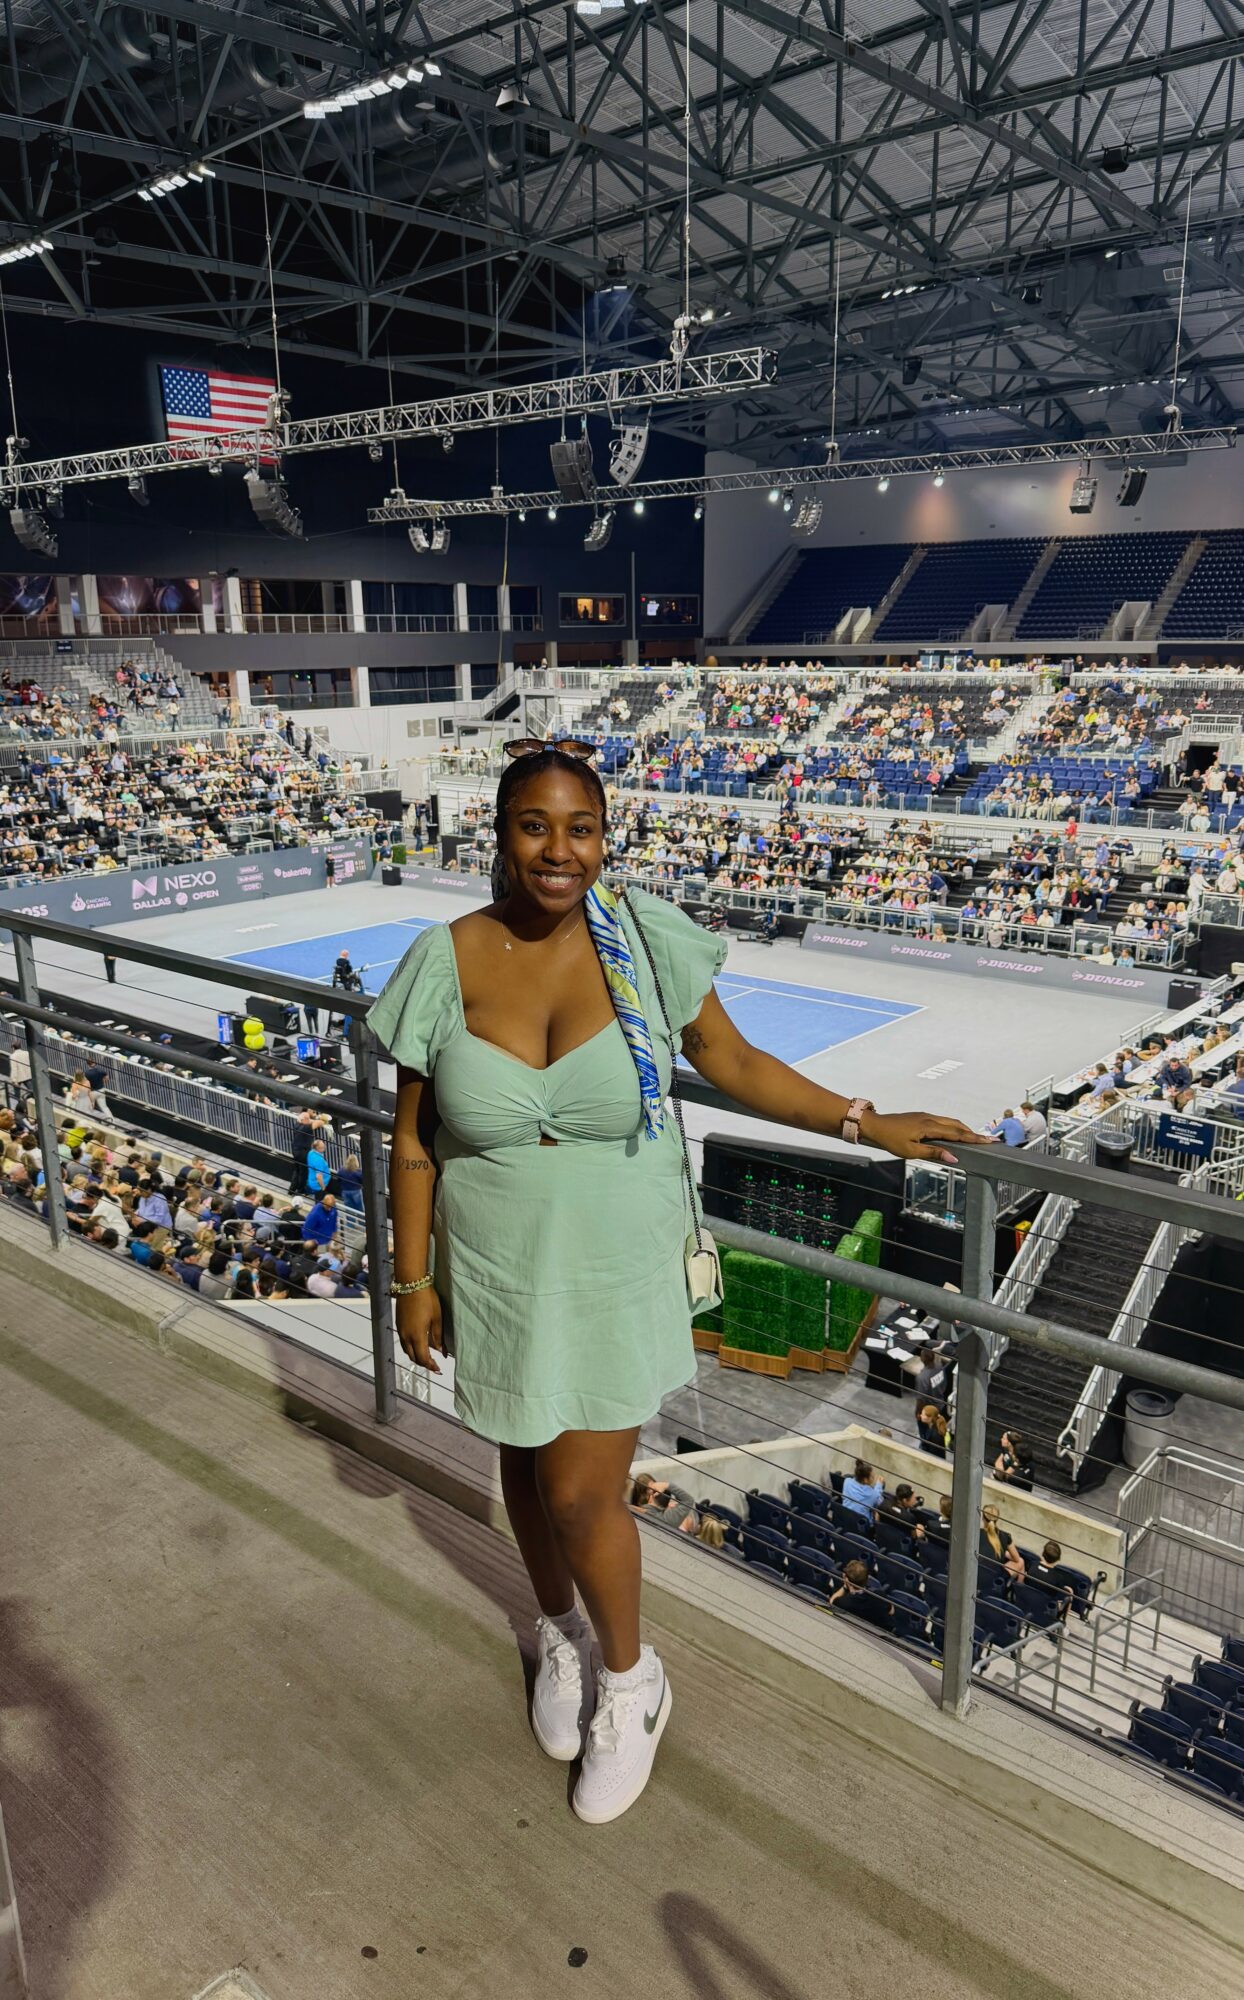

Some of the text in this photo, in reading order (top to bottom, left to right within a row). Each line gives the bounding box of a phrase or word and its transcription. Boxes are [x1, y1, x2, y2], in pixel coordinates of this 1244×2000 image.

[164, 871, 216, 891] NEXO
[132, 889, 219, 910] DALLAS OPEN
[11, 904, 48, 918] OSS
[820, 935, 868, 948] DUNLOP
[900, 947, 952, 960] DUNLOP
[987, 959, 1044, 974] DUNLOP
[1083, 973, 1146, 989] DUNLOP
[405, 1159, 429, 1170] 1970
